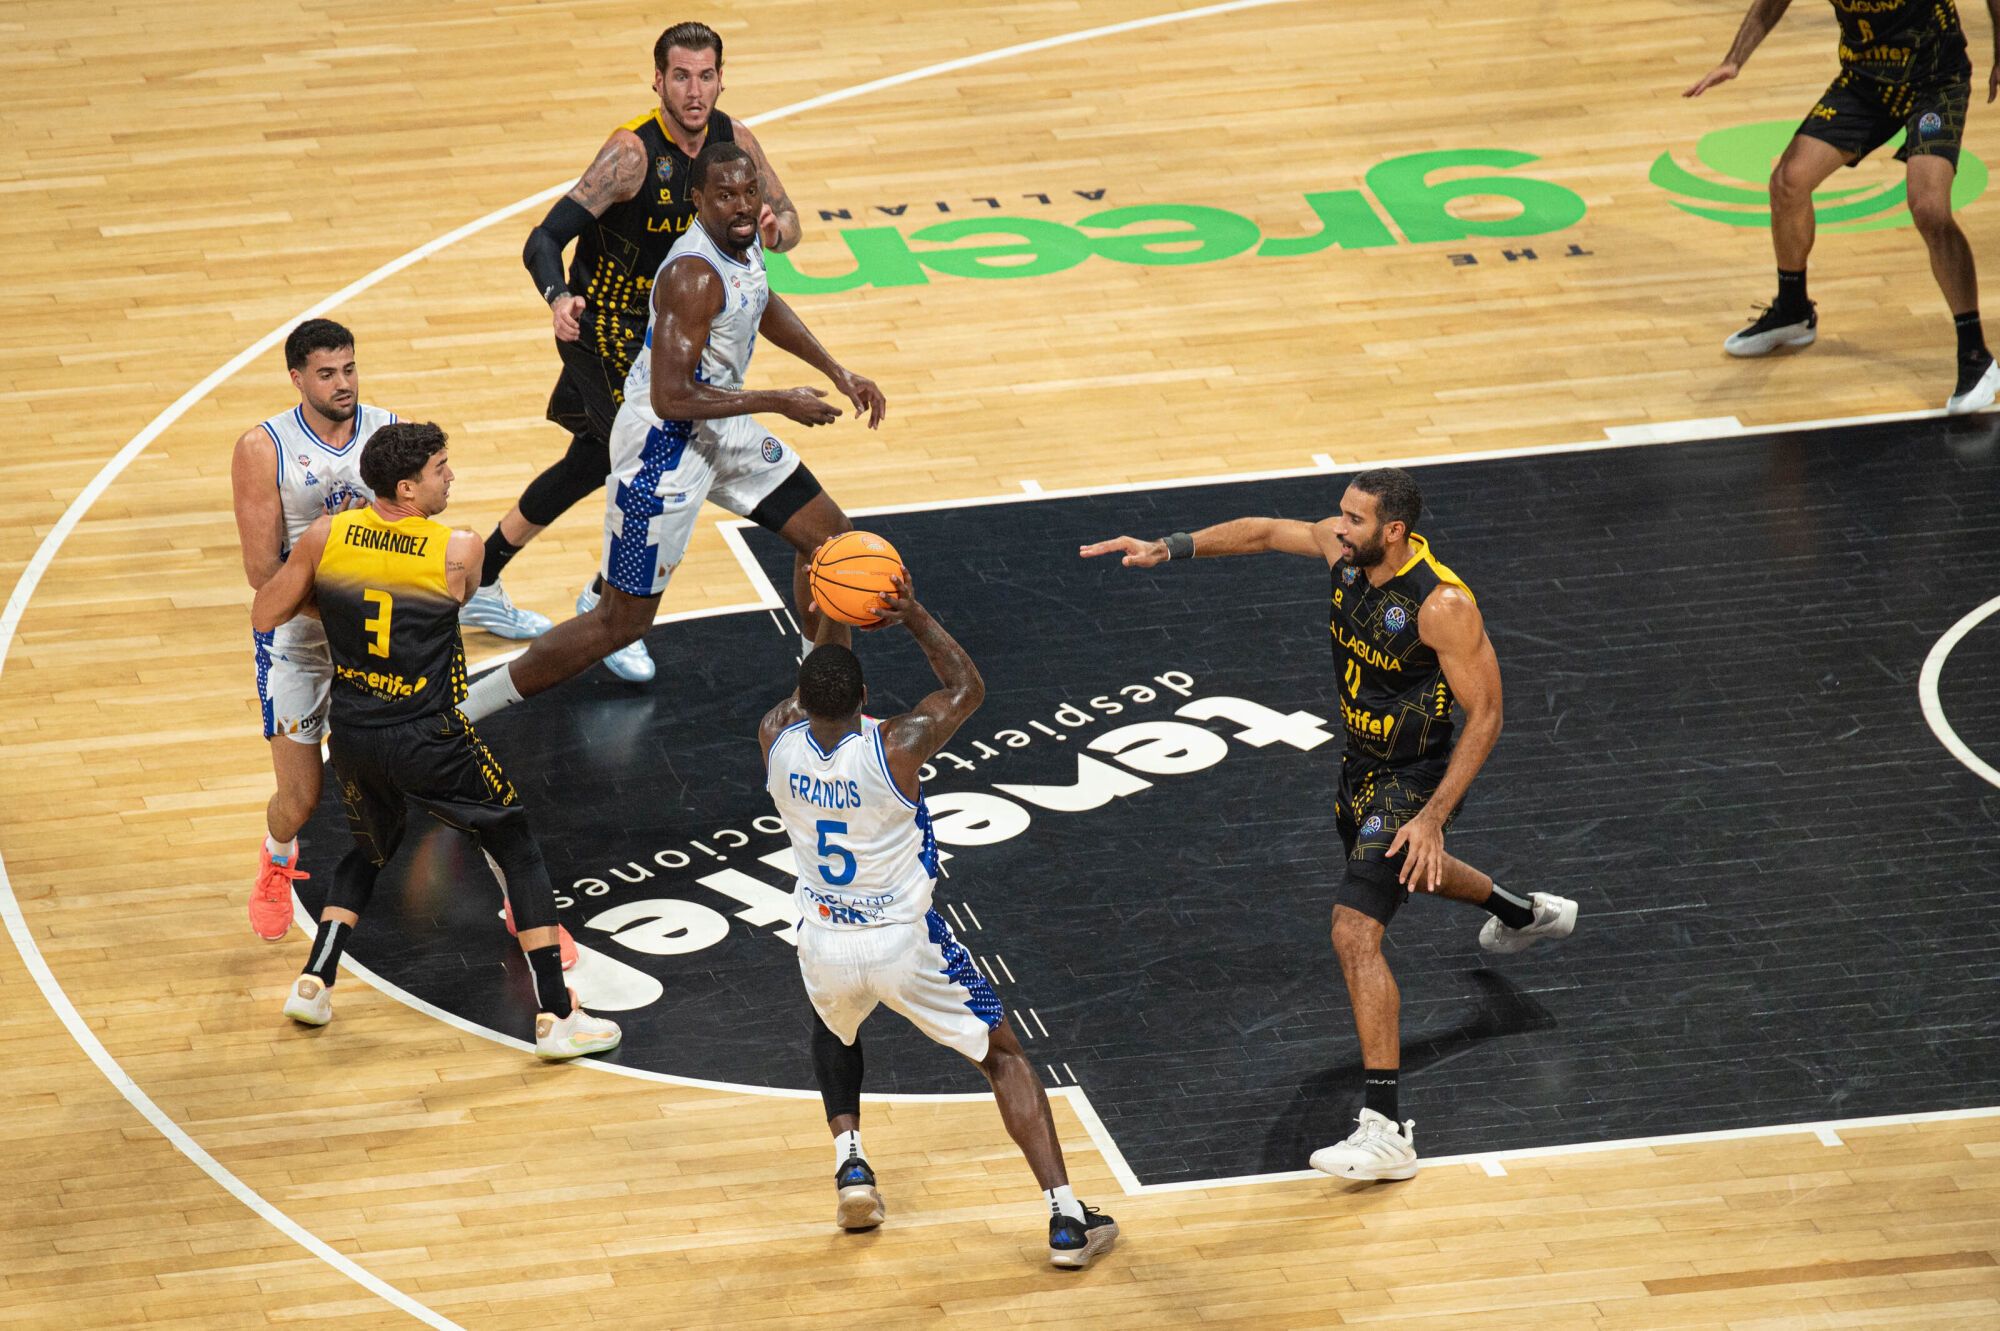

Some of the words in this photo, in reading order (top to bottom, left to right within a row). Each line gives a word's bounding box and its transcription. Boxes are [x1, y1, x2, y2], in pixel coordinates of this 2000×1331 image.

[646, 216, 672, 233] LA
[768, 147, 1587, 295] green
[817, 186, 1109, 221] ALLIAN
[1445, 243, 1594, 267] THE
[363, 587, 394, 659] 3
[1338, 626, 1403, 673] LAGUNA
[789, 773, 862, 810] FRANCIS
[815, 819, 858, 886] 5
